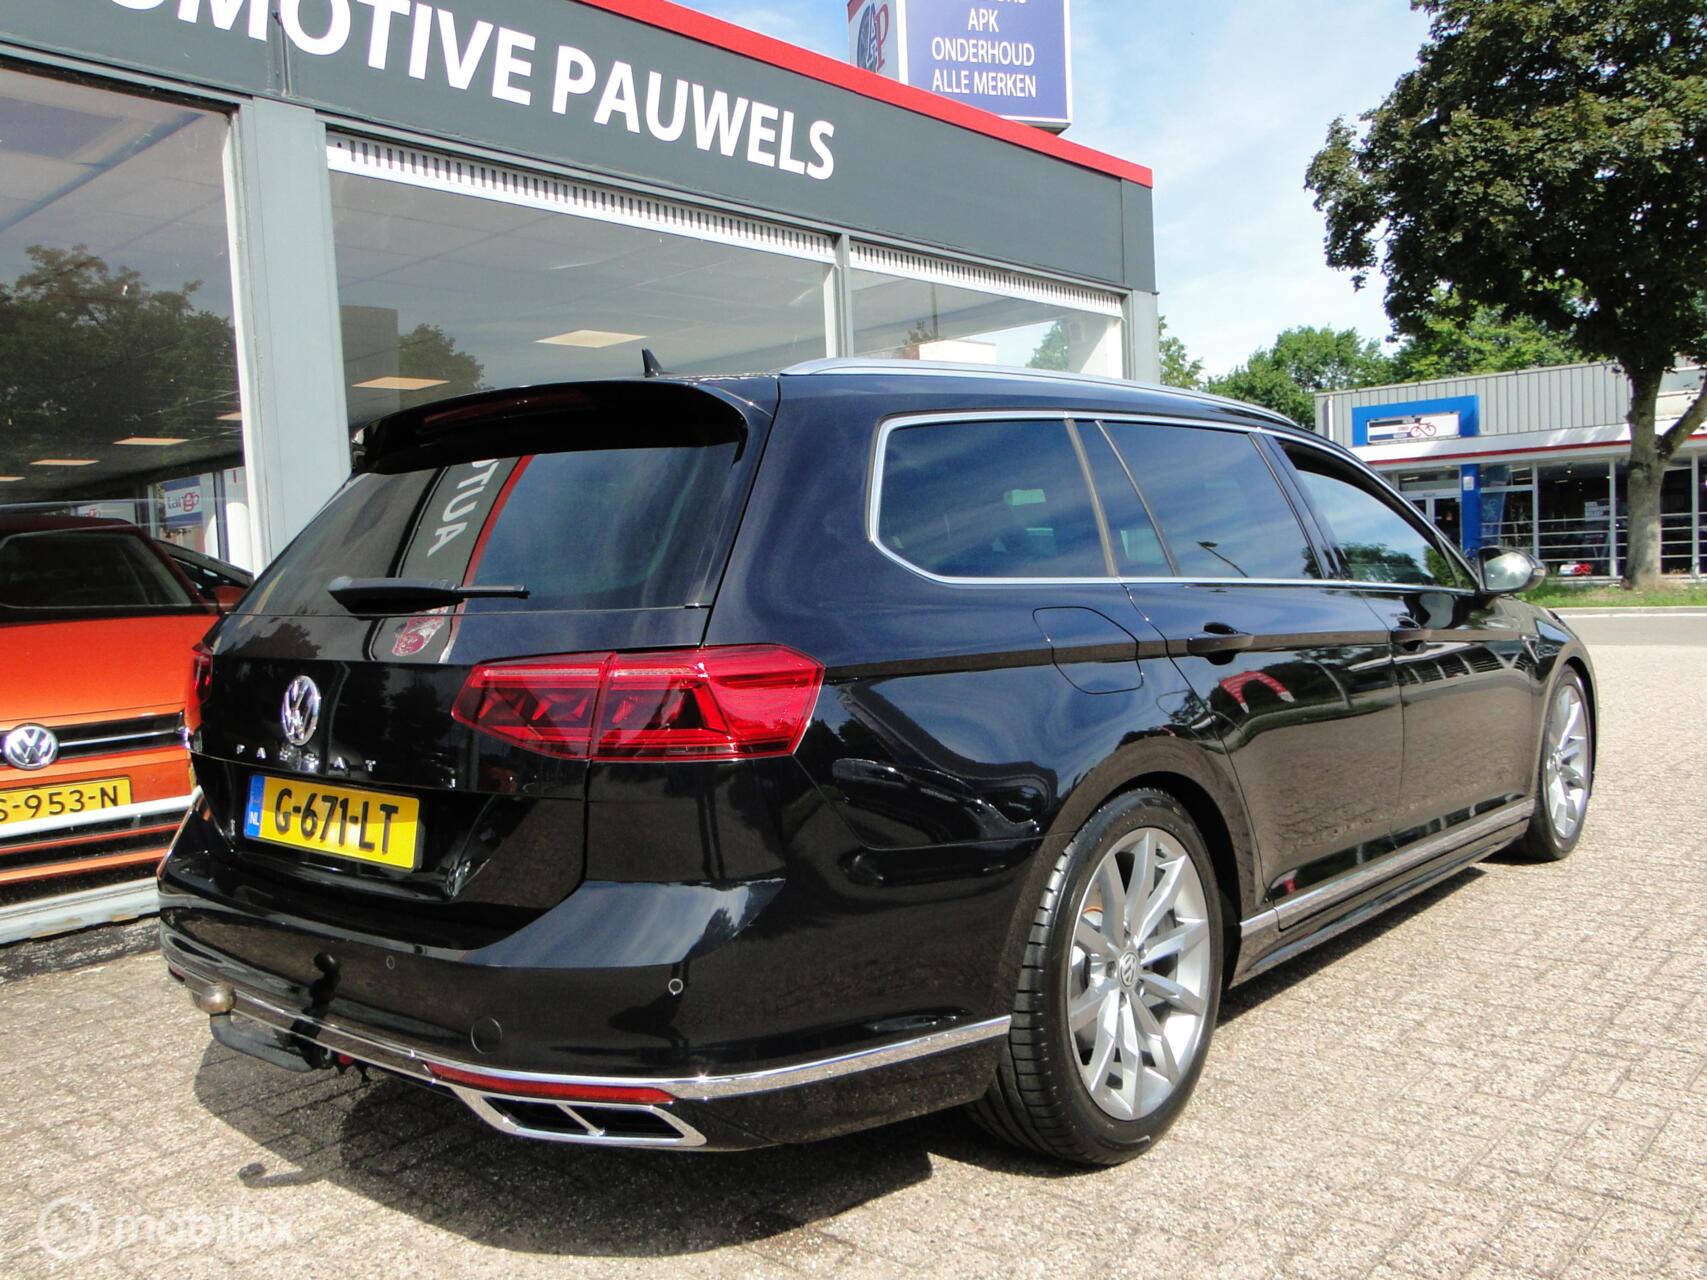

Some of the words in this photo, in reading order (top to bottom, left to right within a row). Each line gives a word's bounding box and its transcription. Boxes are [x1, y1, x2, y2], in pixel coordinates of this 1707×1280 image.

[967, 8, 999, 32] APK
[932, 37, 1035, 66] ONDERHOUD
[112, 0, 537, 106] OTIVE
[552, 45, 834, 180] PAUWELS
[932, 69, 970, 93] ALLE
[974, 71, 1036, 98] MERKEN
[236, 744, 377, 772] PASSAT
[249, 811, 260, 826] NL
[274, 787, 399, 855] G-671-LT
